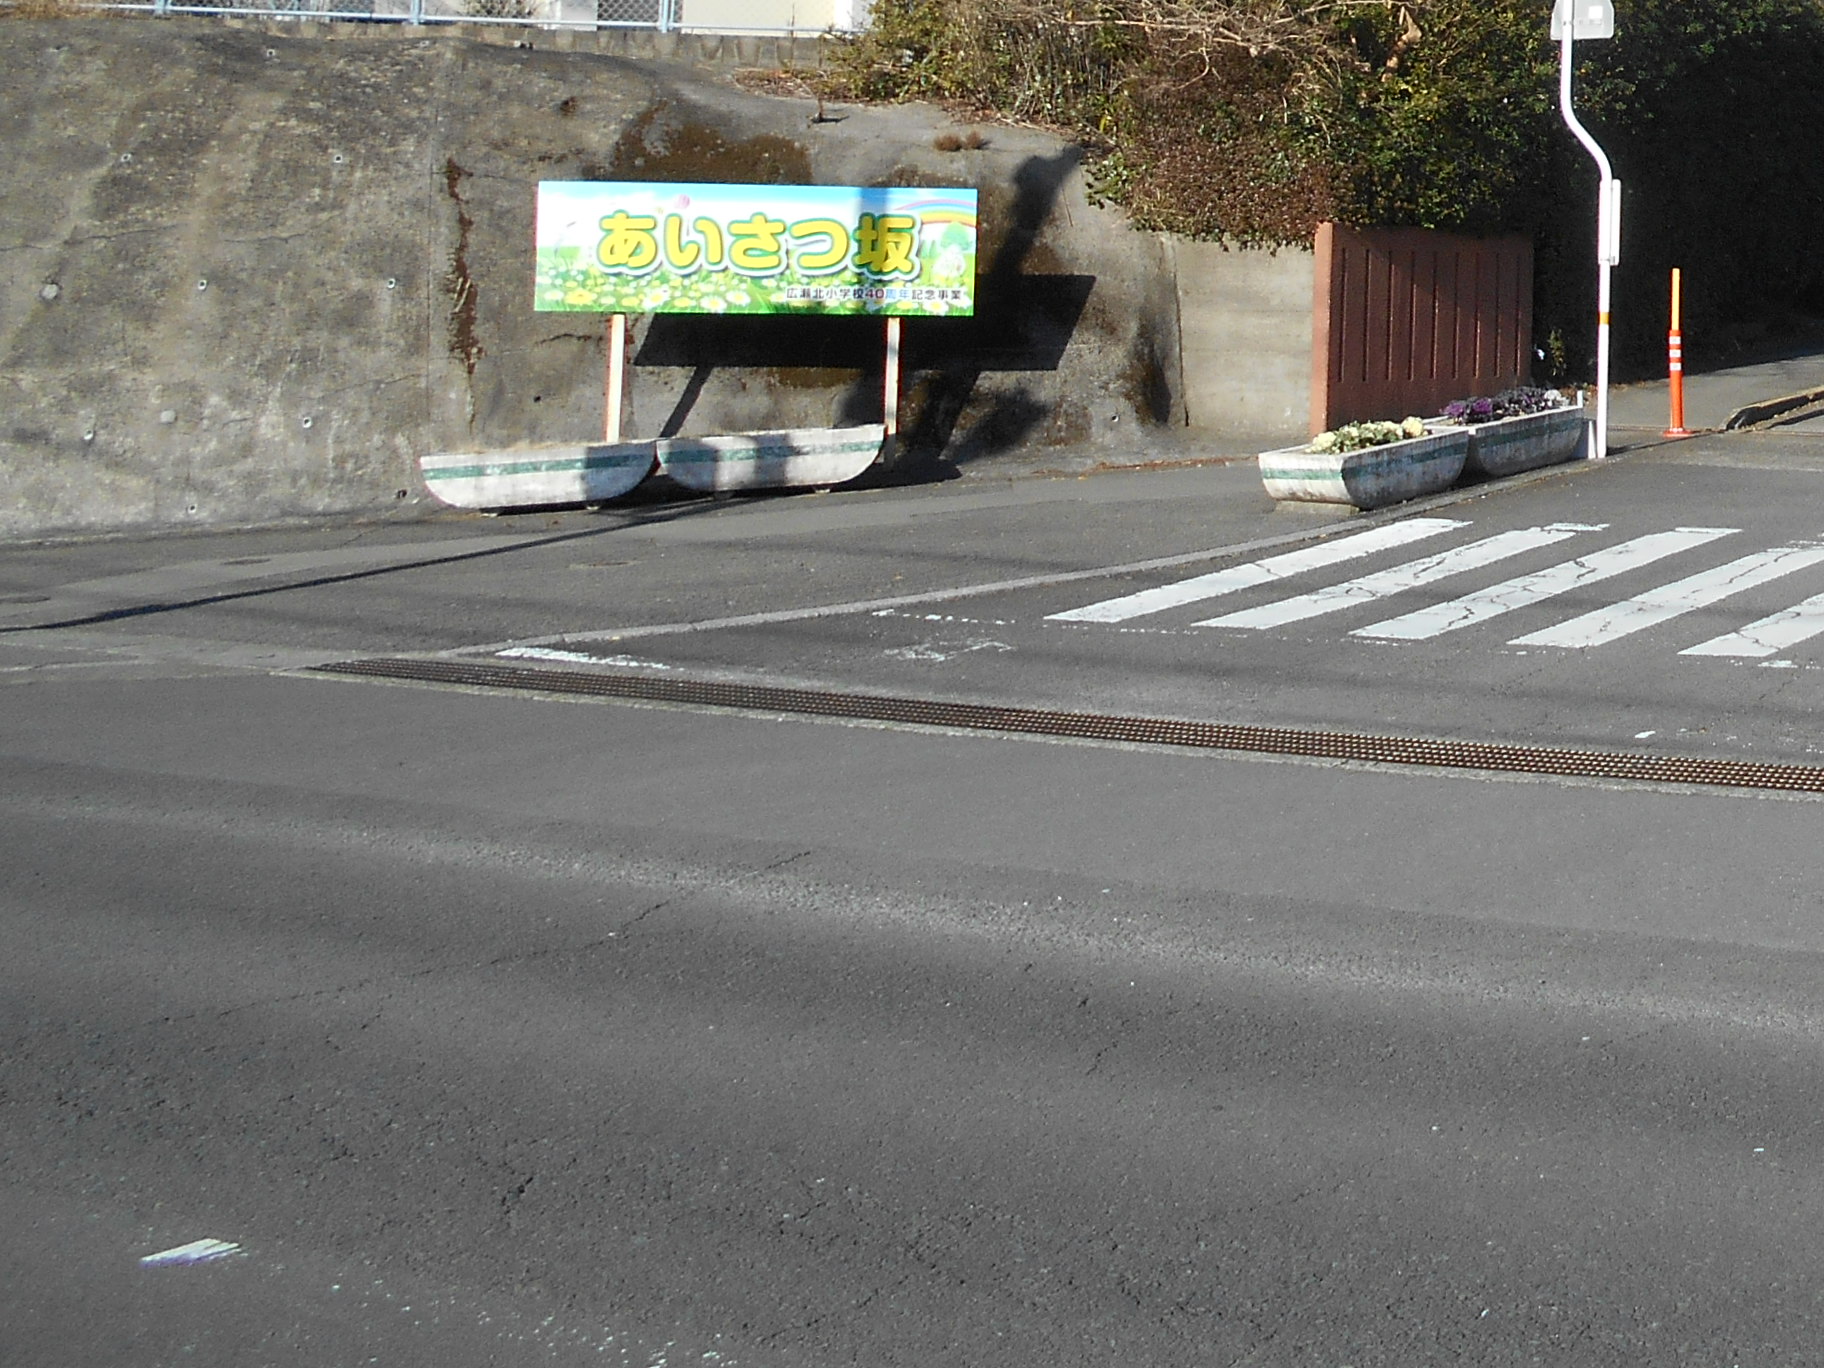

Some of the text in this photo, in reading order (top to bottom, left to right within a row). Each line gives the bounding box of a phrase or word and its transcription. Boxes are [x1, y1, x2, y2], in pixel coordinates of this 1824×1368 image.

[597, 209, 915, 276] あいさつ坂
